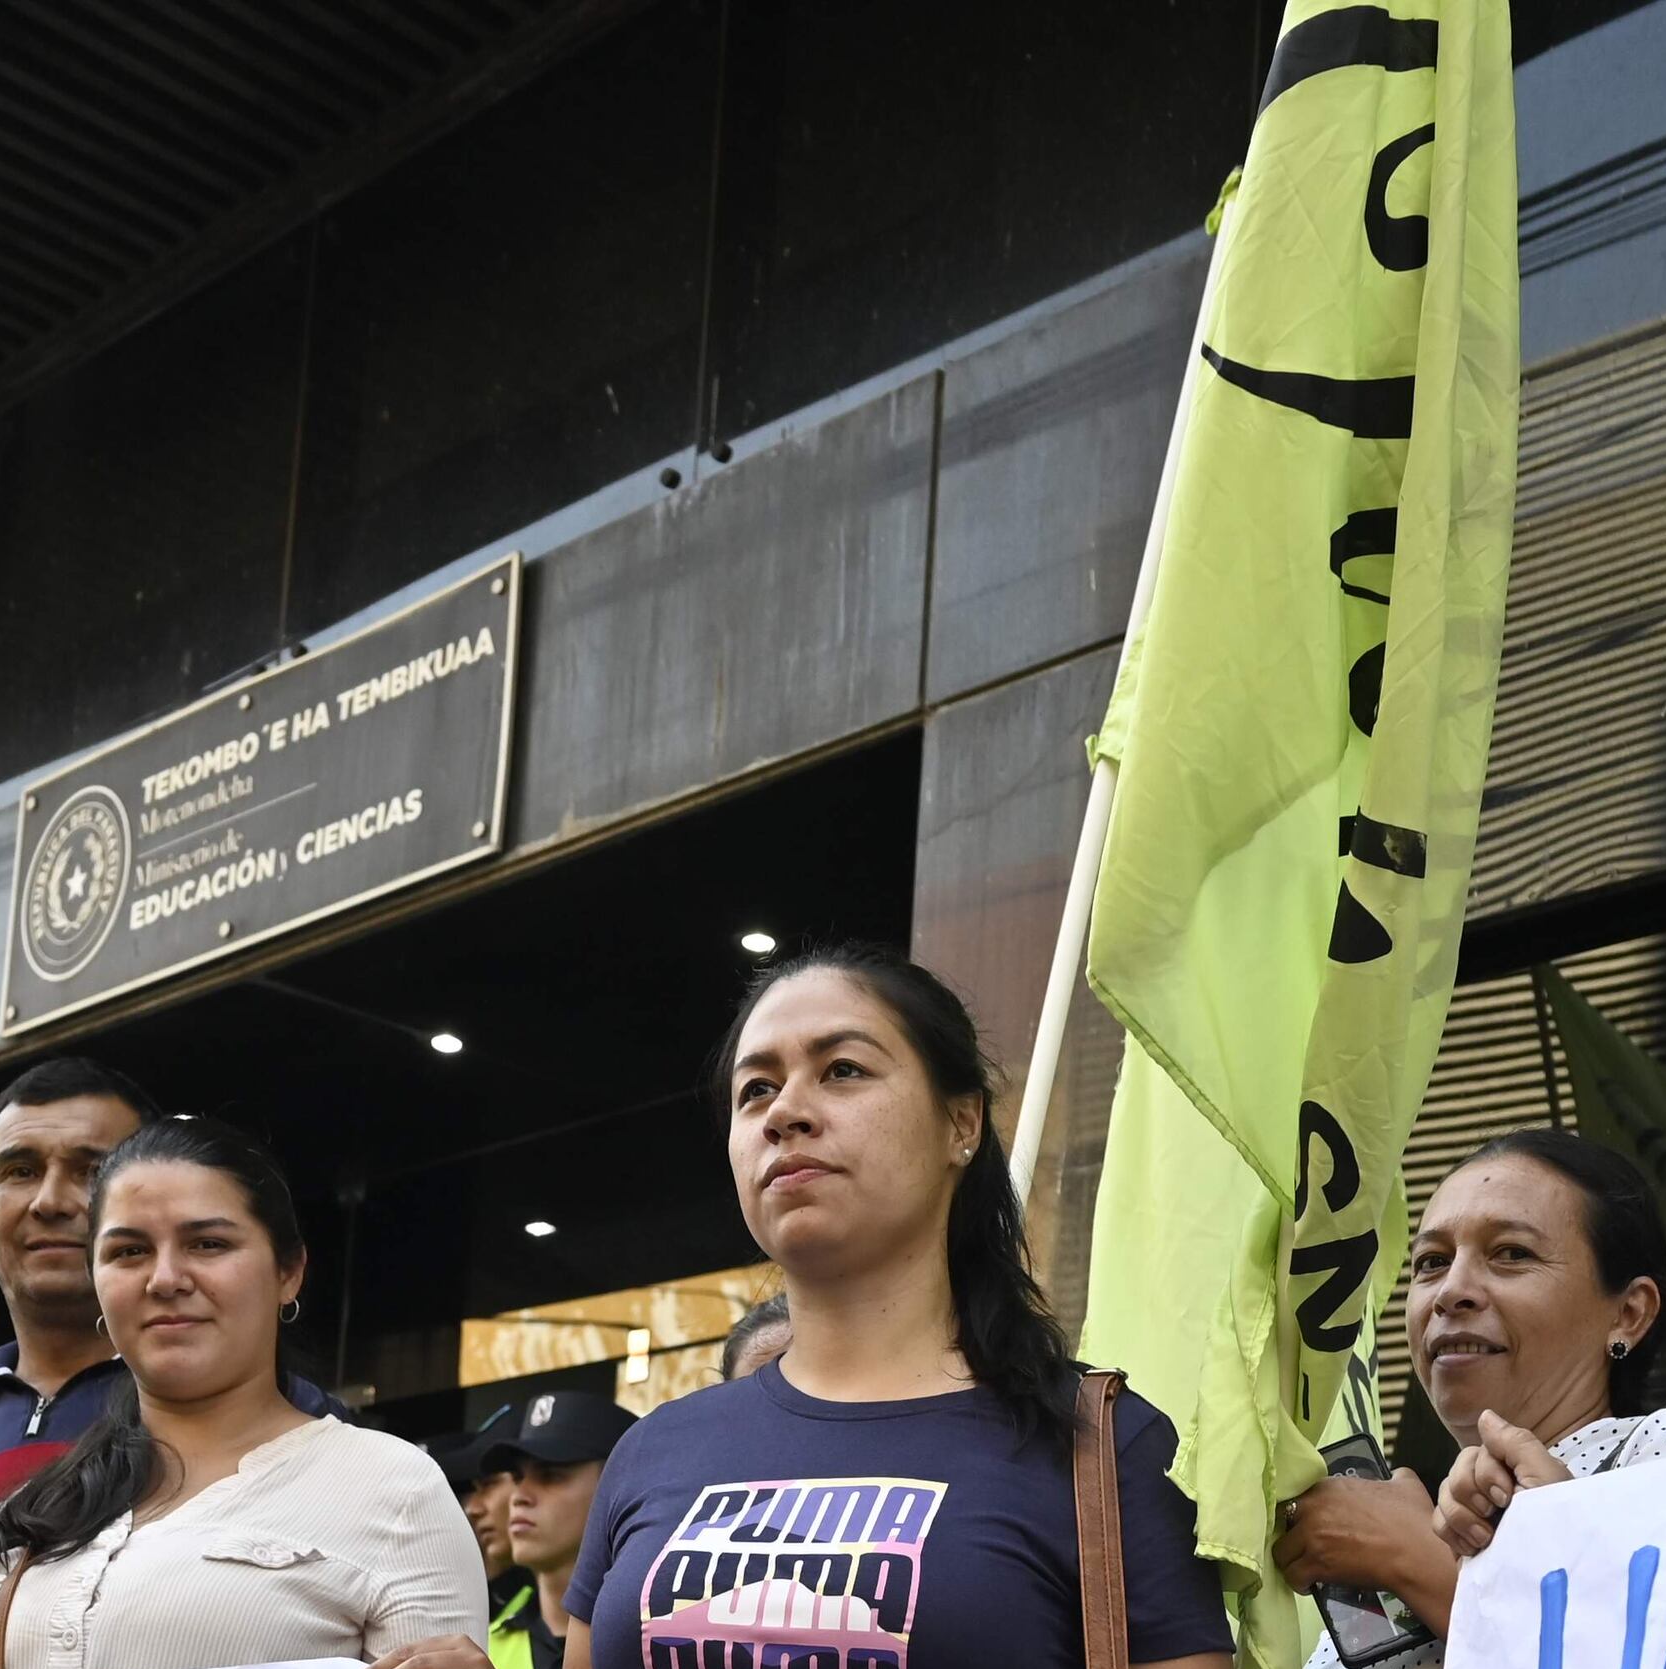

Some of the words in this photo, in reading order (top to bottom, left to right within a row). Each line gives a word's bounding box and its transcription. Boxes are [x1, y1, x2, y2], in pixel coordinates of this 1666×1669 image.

[290, 702, 330, 742] HA
[336, 627, 495, 721] TEMBIKUAA
[129, 847, 277, 931] EDUCACIÓN
[296, 788, 424, 865] CIENCIAS
[679, 1485, 938, 1544] PUMA
[648, 1550, 915, 1634] PUMA
